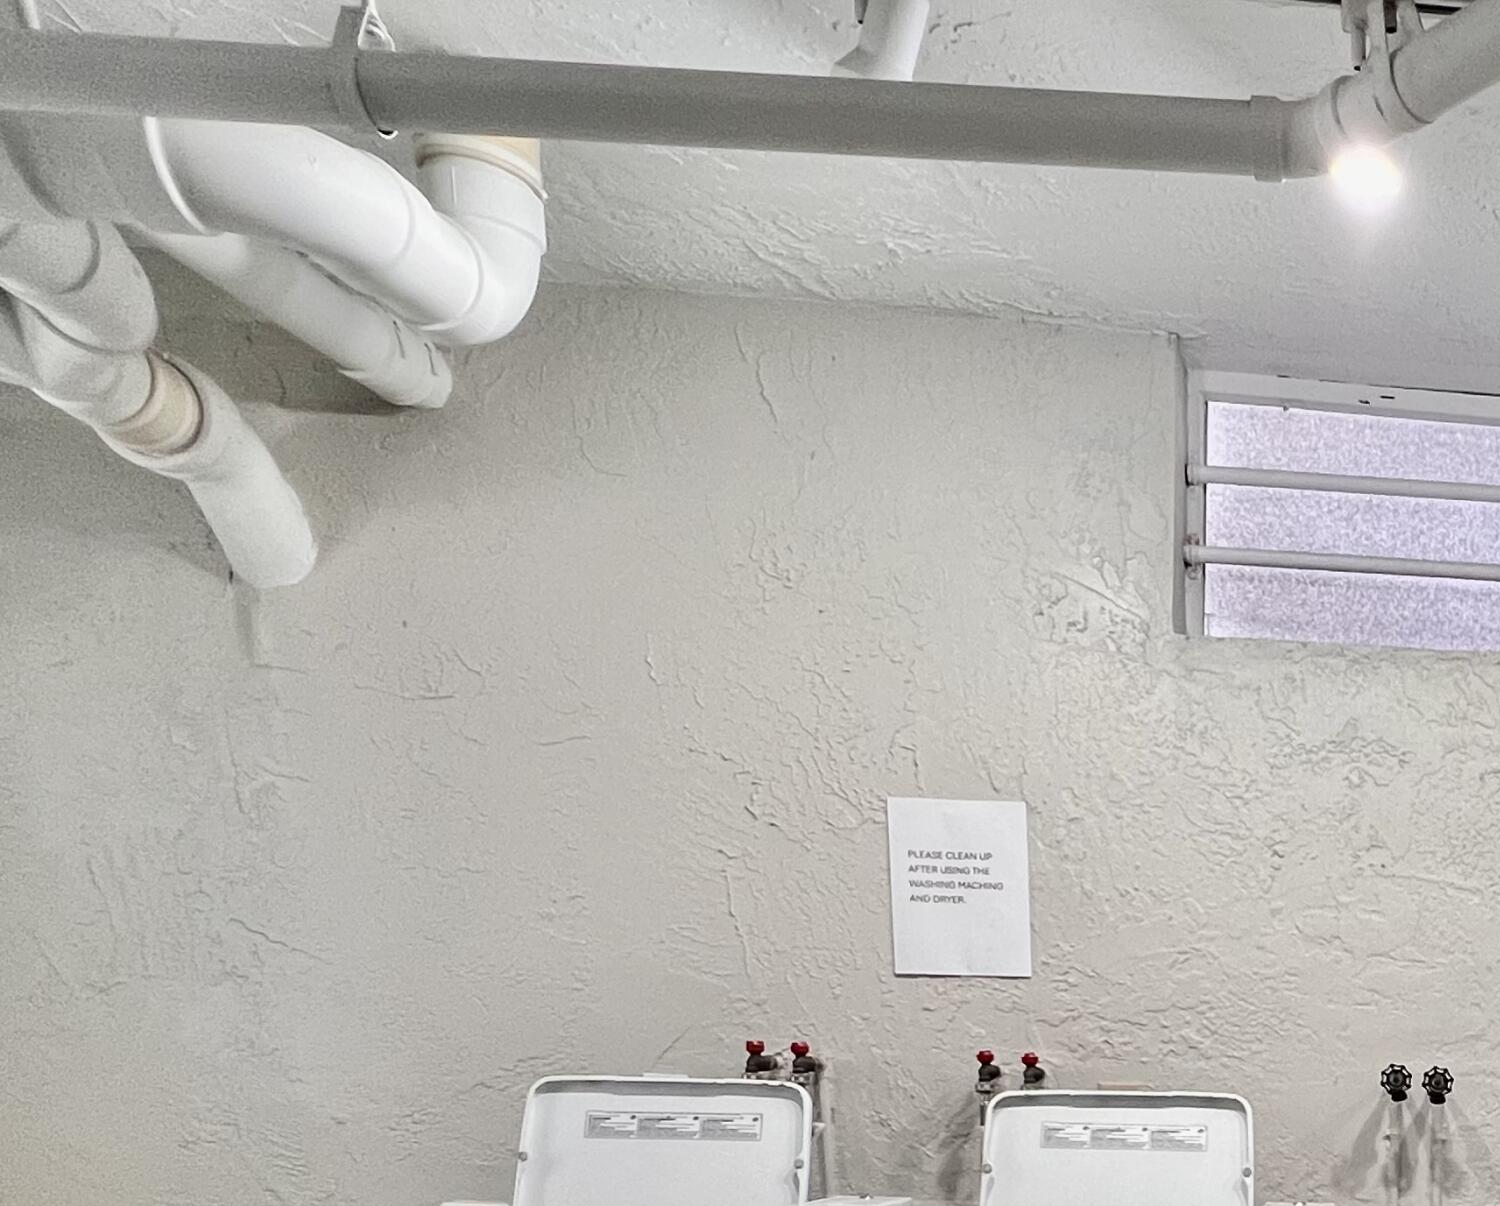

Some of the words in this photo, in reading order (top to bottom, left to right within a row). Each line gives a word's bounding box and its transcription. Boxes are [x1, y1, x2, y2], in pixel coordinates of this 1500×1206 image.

[907, 850, 943, 859] PLEASE
[945, 851, 977, 860] CLEAN
[979, 852, 993, 861] UP
[908, 864, 938, 873] AFTER
[940, 866, 970, 875] USING
[972, 866, 991, 875] THE
[909, 880, 955, 889] WASHING
[909, 894, 931, 903] AND
